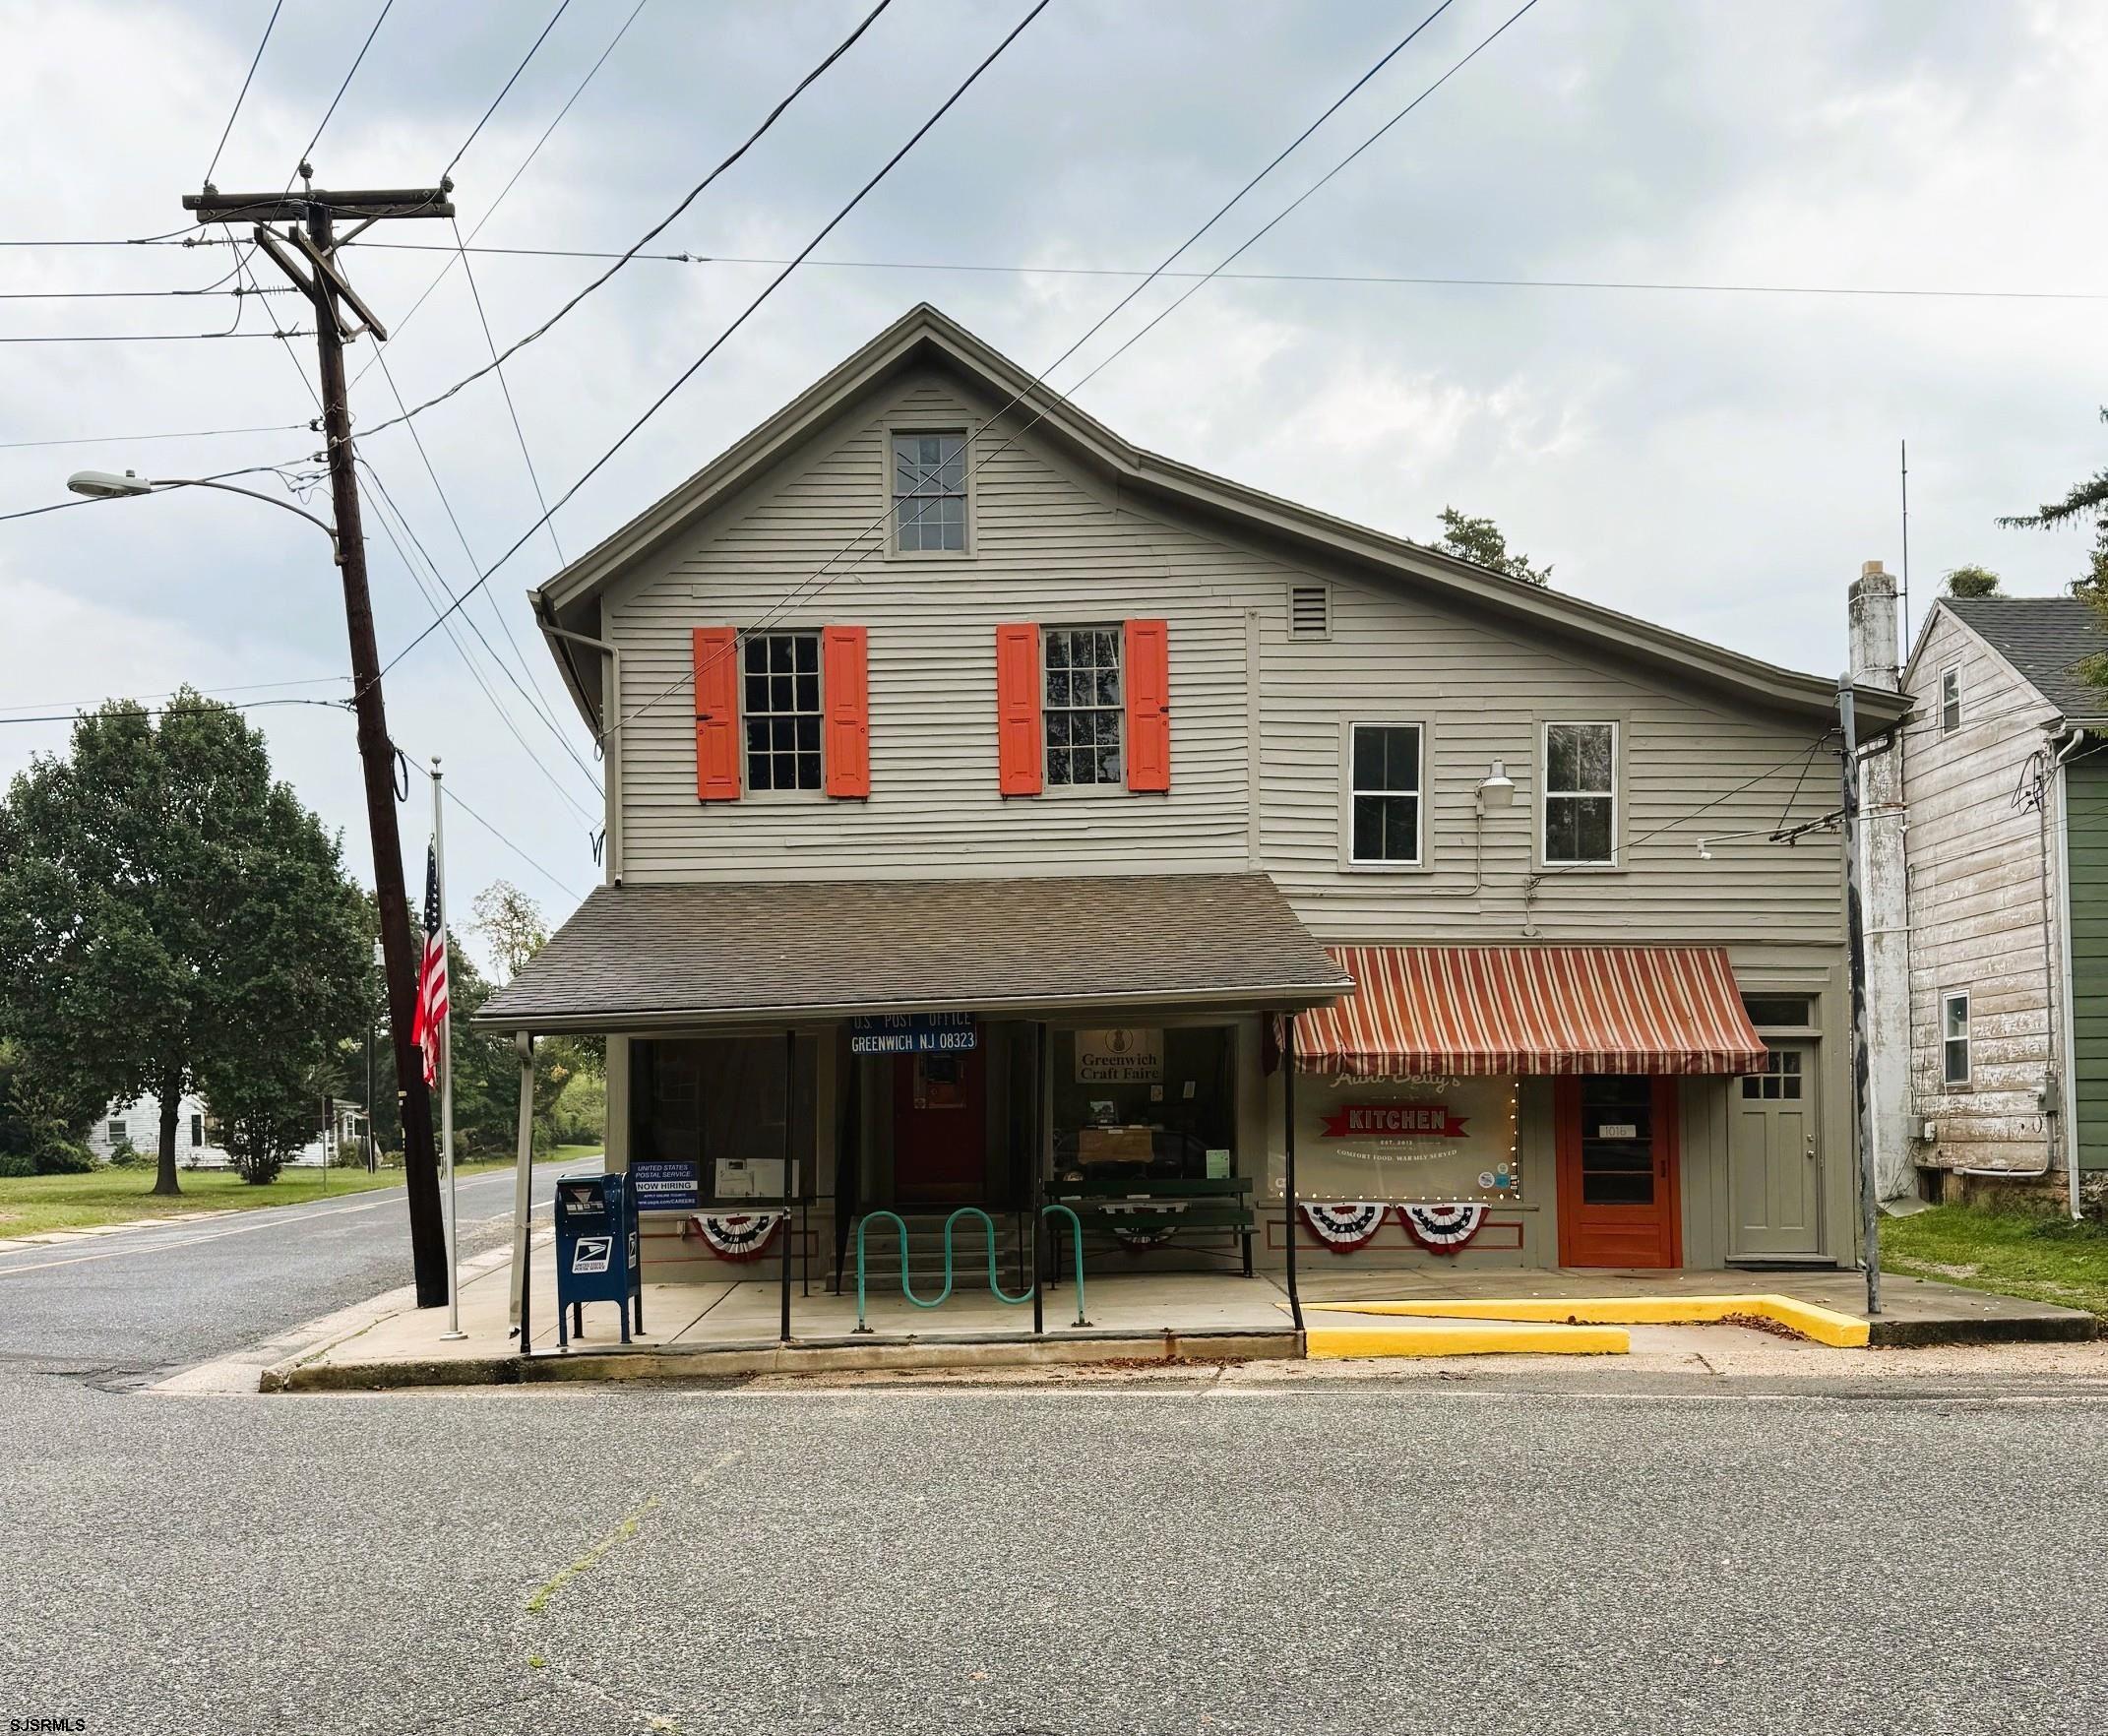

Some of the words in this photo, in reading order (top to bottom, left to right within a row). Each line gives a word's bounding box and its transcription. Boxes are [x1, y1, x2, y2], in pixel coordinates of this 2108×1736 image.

[851, 1035, 913, 1052] GREENWICH
[919, 1034, 935, 1049] NJ
[939, 1032, 974, 1049] 08323
[1083, 1053, 1156, 1066] Greenwich
[1081, 1067, 1119, 1080] Craft
[1123, 1067, 1159, 1080] Faire
[1349, 1109, 1446, 1131] KITCHEN
[1336, 1148, 1371, 1160] COMFORT
